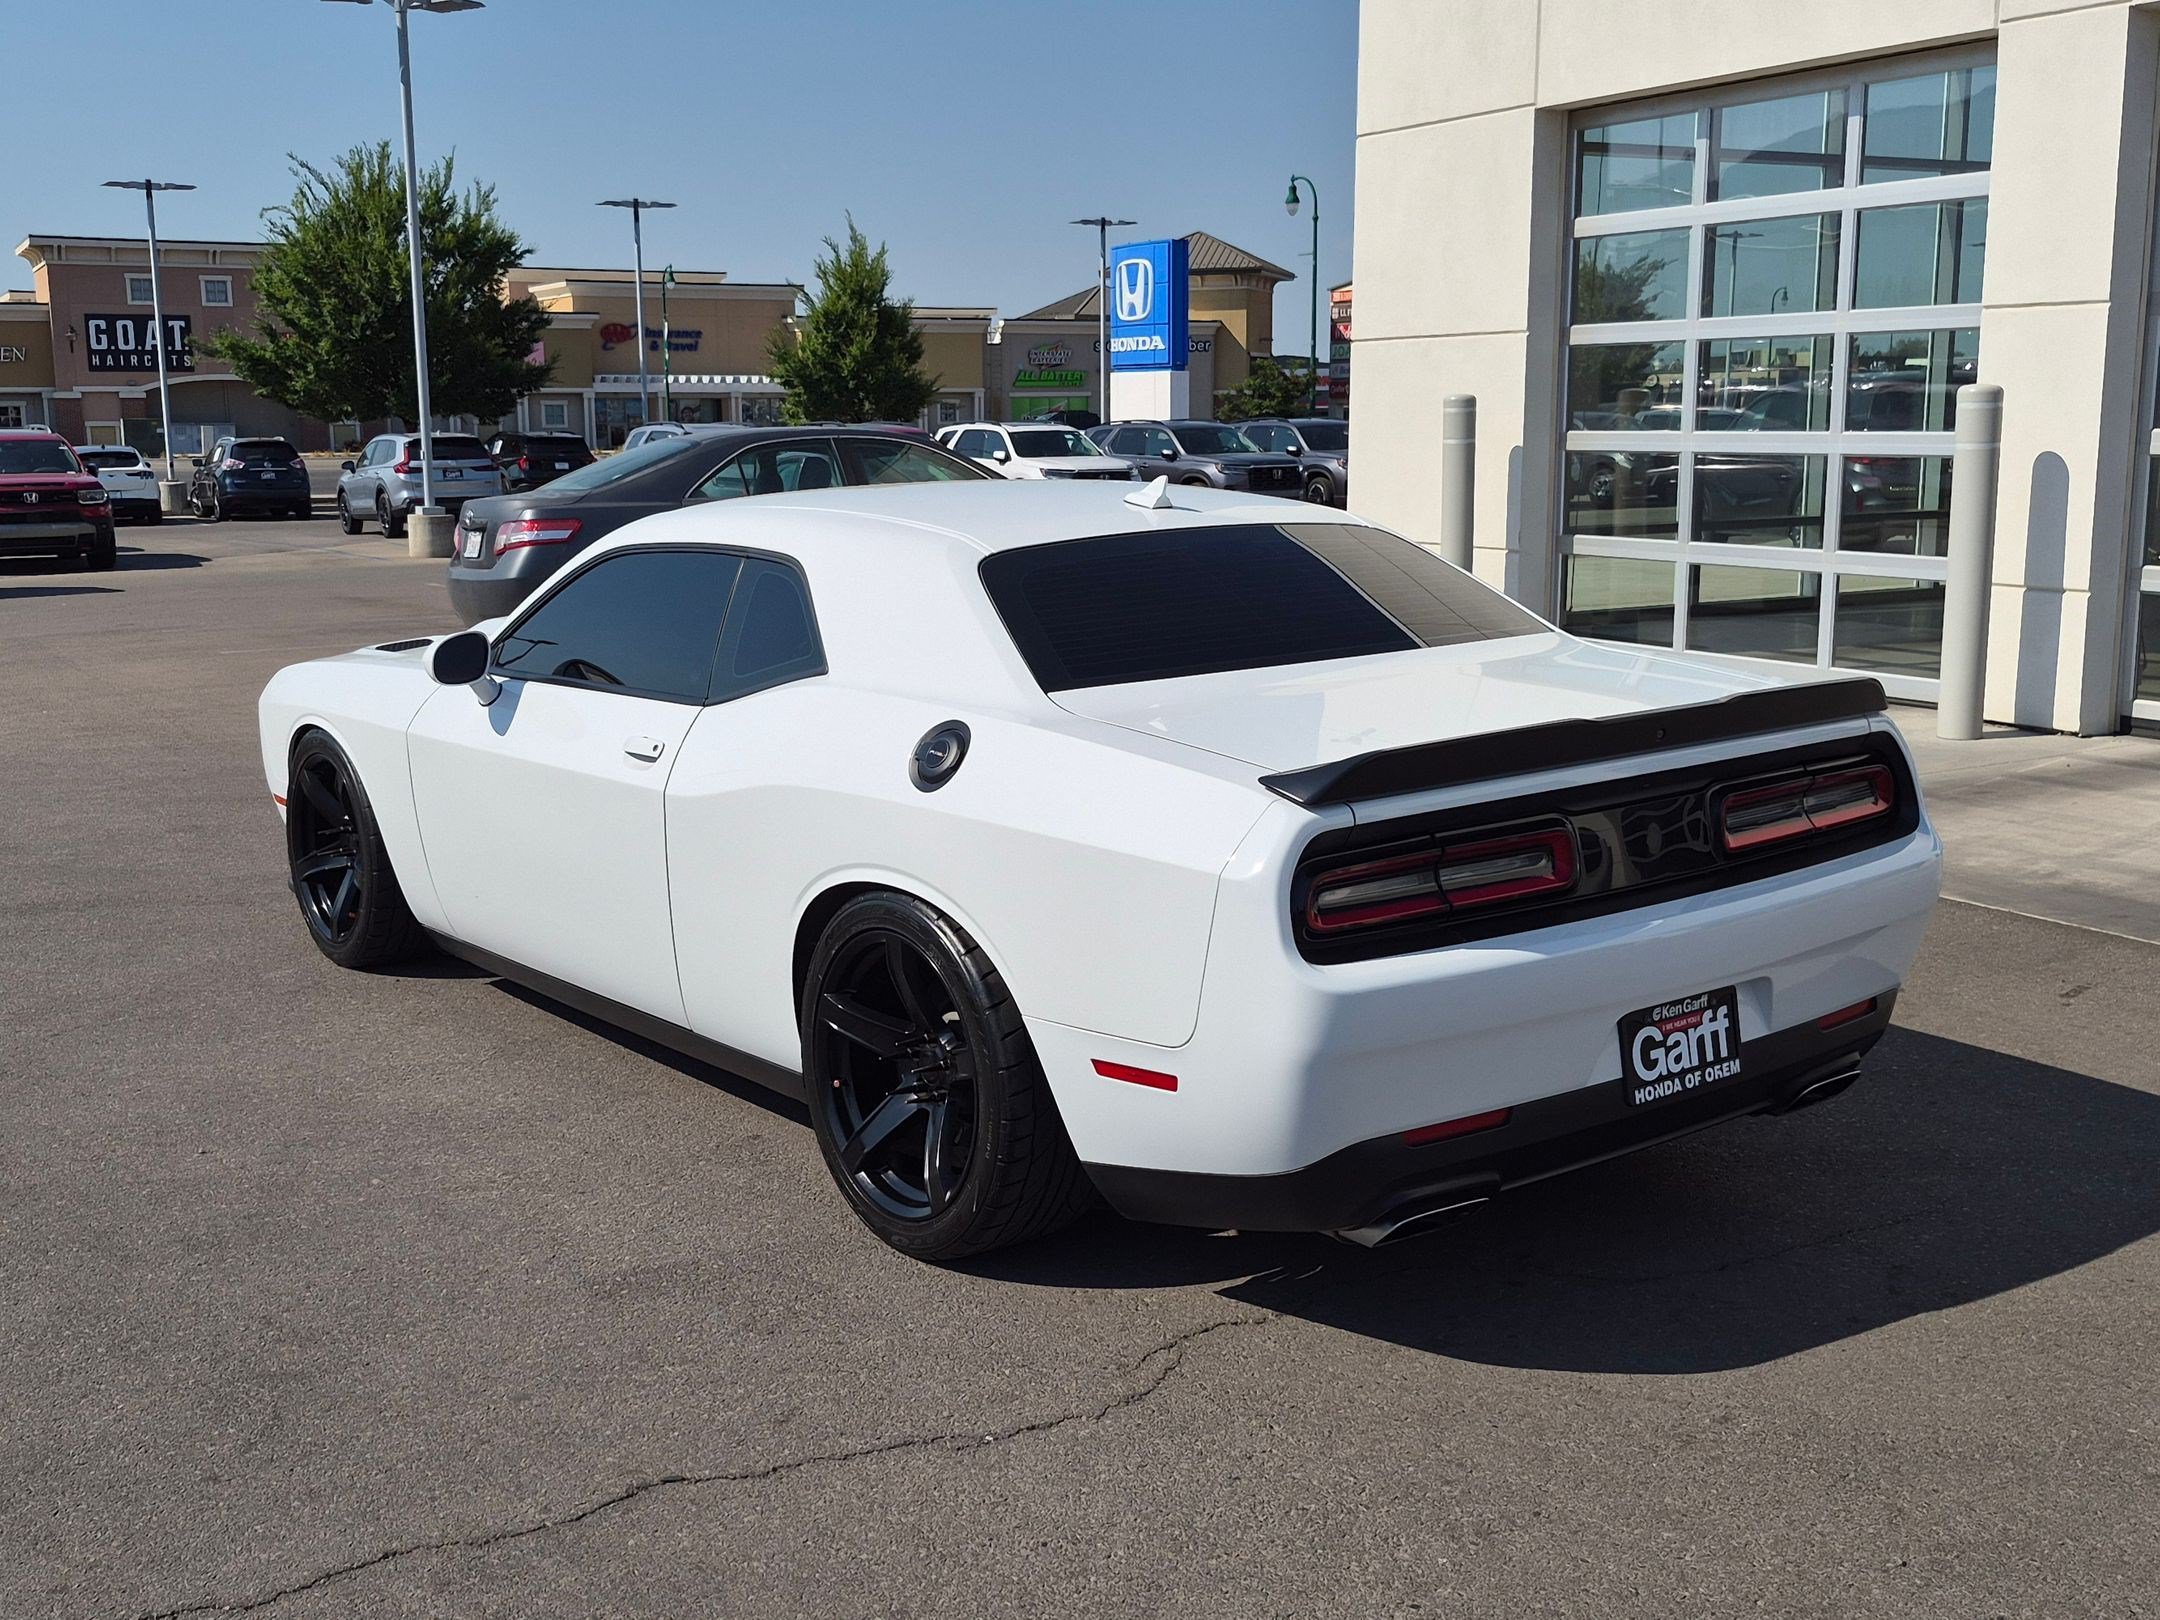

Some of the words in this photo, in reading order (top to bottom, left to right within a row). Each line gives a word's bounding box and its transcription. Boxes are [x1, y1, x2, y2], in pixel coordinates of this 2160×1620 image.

[644, 327, 703, 339] Insrance
[665, 341, 699, 352] ravel
[1110, 335, 1166, 353] HONDA
[1188, 338, 1212, 352] ber
[92, 354, 192, 367] HAIRCTS
[1017, 370, 1038, 381] ALL
[1040, 370, 1088, 381] BATTERY
[1662, 1003, 1683, 1020] Ken
[1683, 994, 1709, 1013] Garff
[1632, 1004, 1730, 1082] Garff
[1634, 1077, 1683, 1105] HONDA
[1684, 1070, 1702, 1089] OF
[1705, 1058, 1741, 1083] OREM
